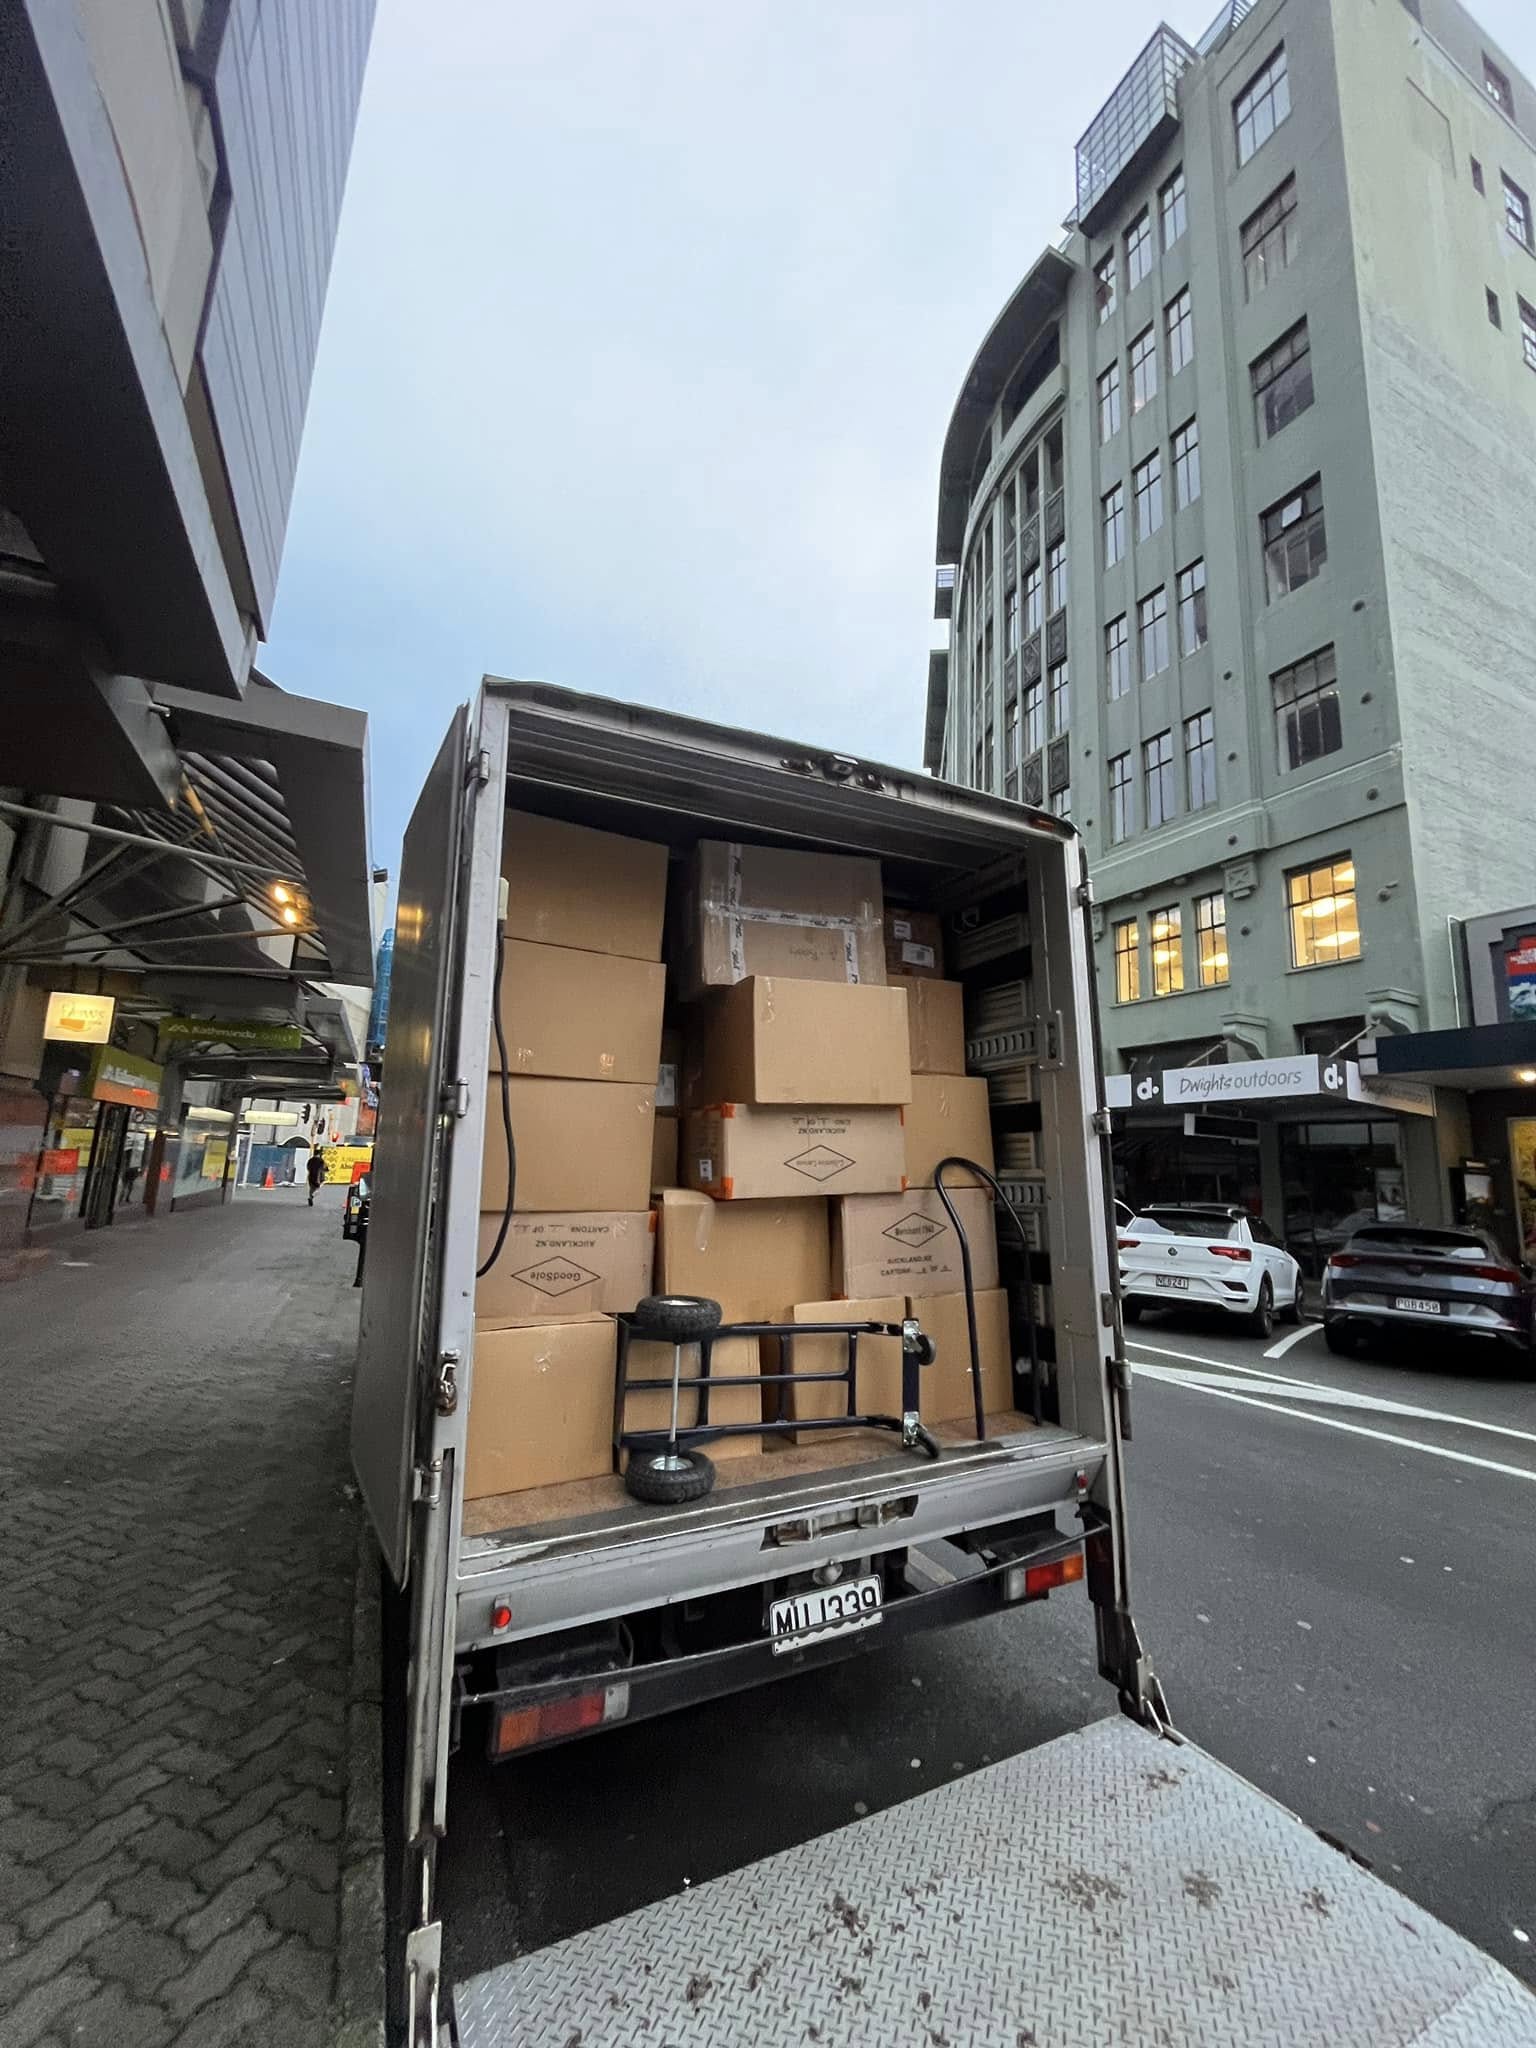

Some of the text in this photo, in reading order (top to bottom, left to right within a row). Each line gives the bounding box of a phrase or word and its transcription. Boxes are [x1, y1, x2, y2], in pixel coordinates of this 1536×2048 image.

[1179, 1070, 1302, 1098] Dwights outdoors
[530, 1271, 581, 1282] GoodSole
